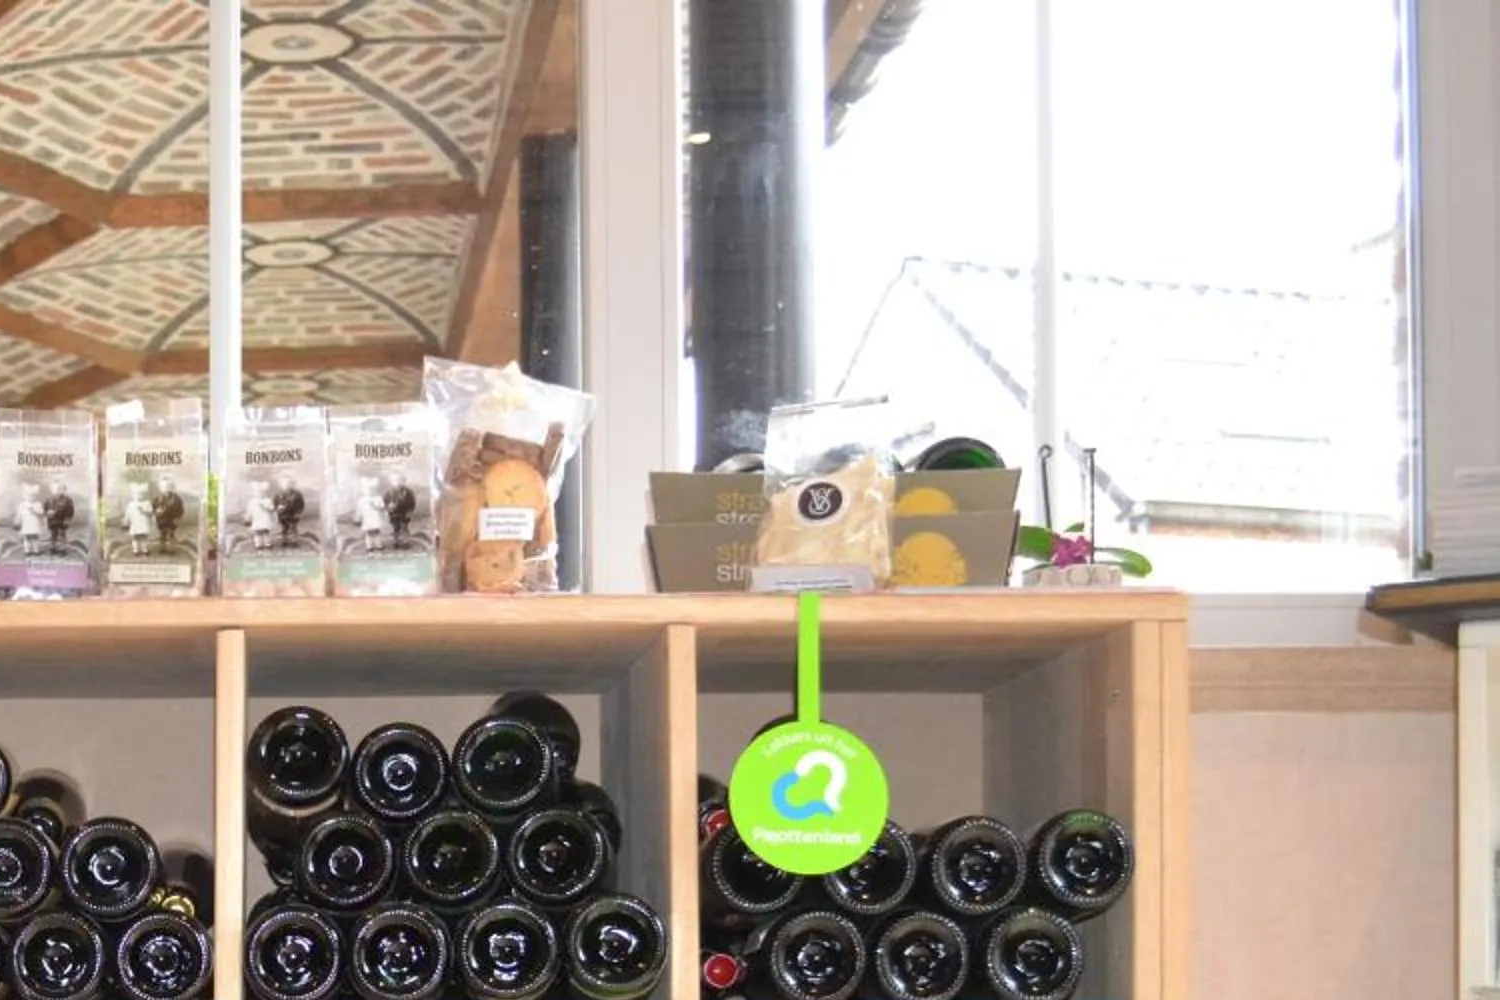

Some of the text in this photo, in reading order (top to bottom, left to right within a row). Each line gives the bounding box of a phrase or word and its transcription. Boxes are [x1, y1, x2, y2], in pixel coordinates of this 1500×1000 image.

[125, 451, 183, 466] BONBONS
[245, 448, 303, 465] BONBONS
[355, 443, 413, 459] BONBONS
[17, 452, 74, 468] BONBONS
